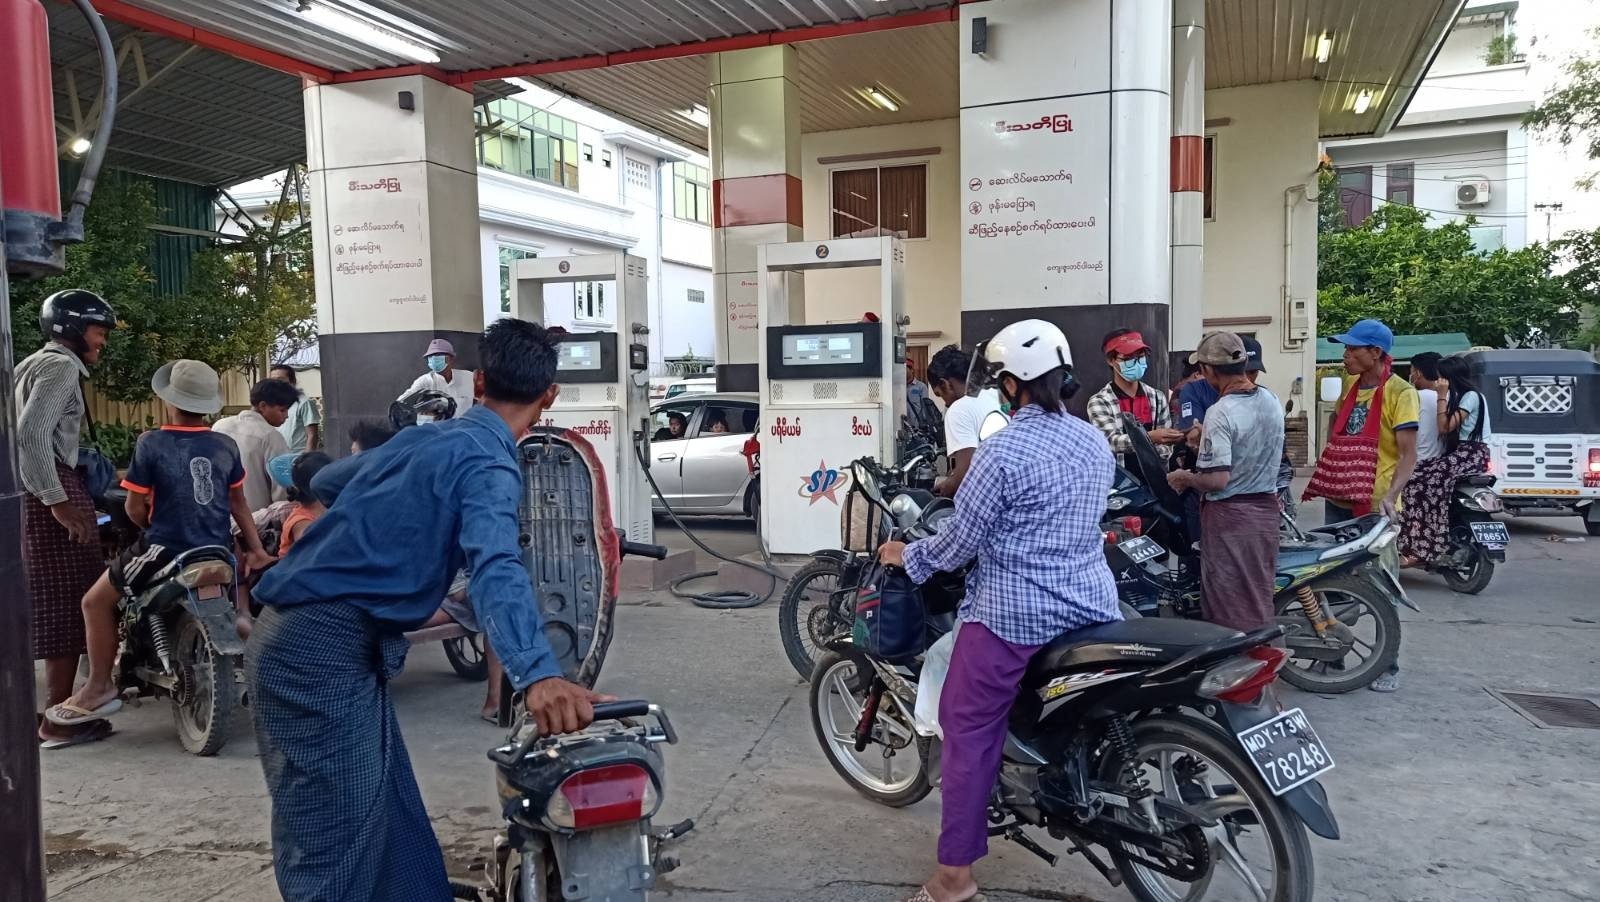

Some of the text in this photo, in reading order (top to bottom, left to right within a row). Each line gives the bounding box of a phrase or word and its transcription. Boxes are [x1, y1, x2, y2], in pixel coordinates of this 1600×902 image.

[988, 169, 1073, 186] ဆေးလိပ်မသောက်ရ
[988, 197, 1036, 214] ဖုန်းမပြောရ
[806, 469, 838, 493] SP
[1477, 532, 1508, 541] 78651
[1244, 714, 1307, 754] MDY-73W
[1264, 743, 1325, 788] 78248
